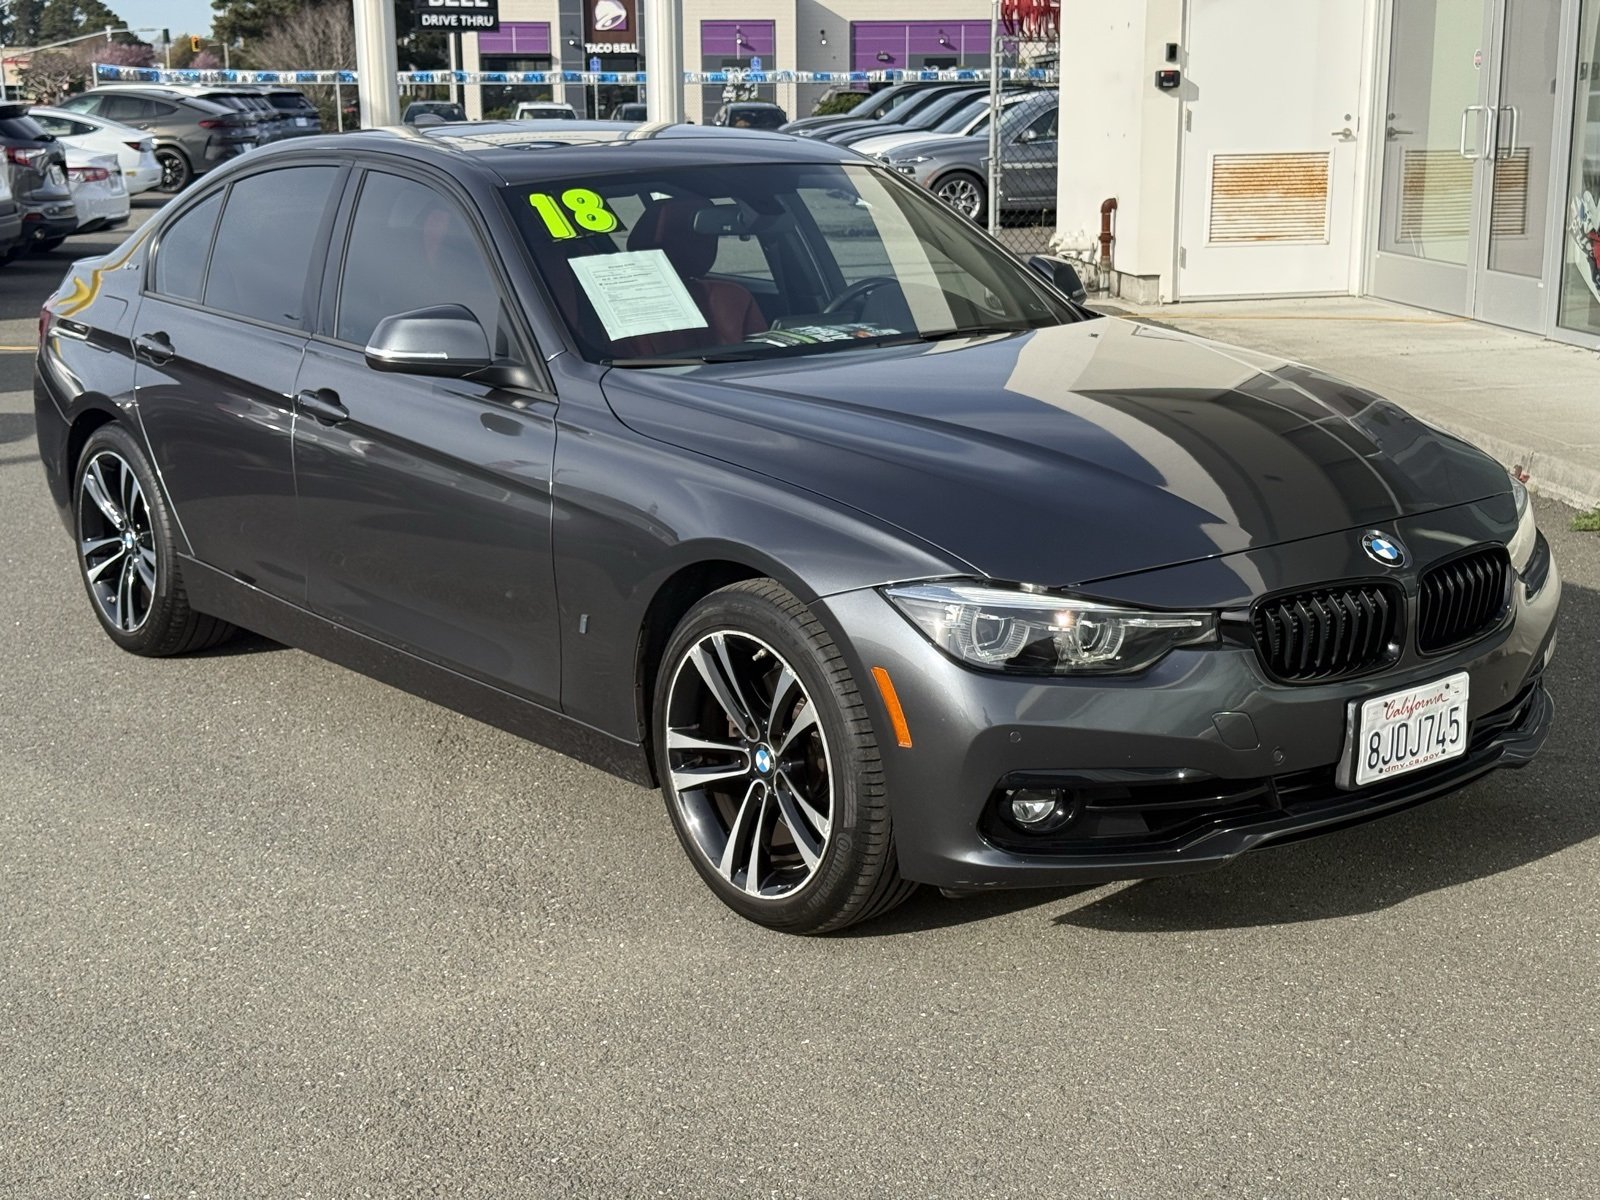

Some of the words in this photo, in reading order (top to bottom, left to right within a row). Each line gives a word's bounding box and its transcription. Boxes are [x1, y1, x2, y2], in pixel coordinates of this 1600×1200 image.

[421, 14, 459, 26] DRIVE
[460, 14, 494, 27] THRU
[585, 42, 613, 54] TACO
[613, 43, 639, 54] BELL
[529, 188, 617, 239] 18
[1385, 692, 1449, 720] California
[1384, 751, 1440, 773] dmv.ca.gov
